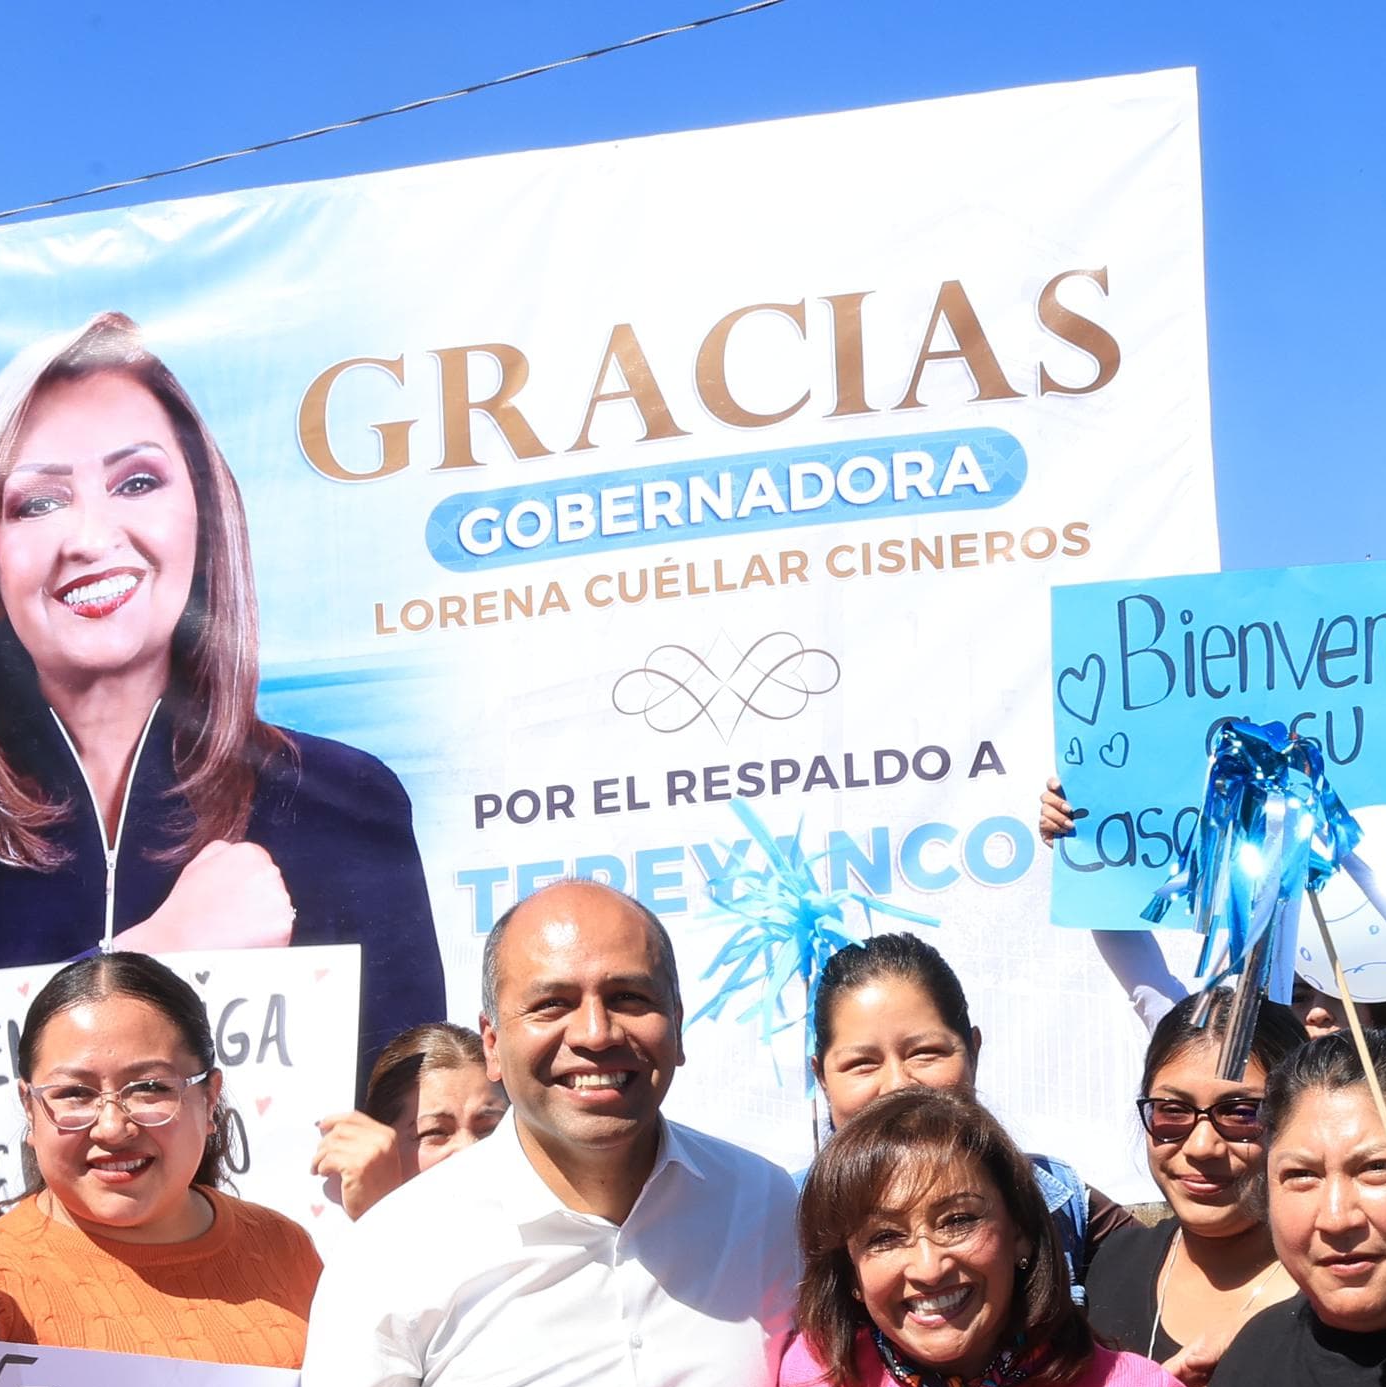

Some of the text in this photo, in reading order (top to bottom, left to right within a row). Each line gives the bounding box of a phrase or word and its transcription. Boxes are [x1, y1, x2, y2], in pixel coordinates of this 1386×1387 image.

[297, 266, 1122, 484] GRACIAS
[457, 444, 990, 557] GOBERNADORA
[374, 521, 1093, 636] LORENA CUÉLLAR CISNEROS
[473, 740, 1006, 830] POR EL RESPALDO A
